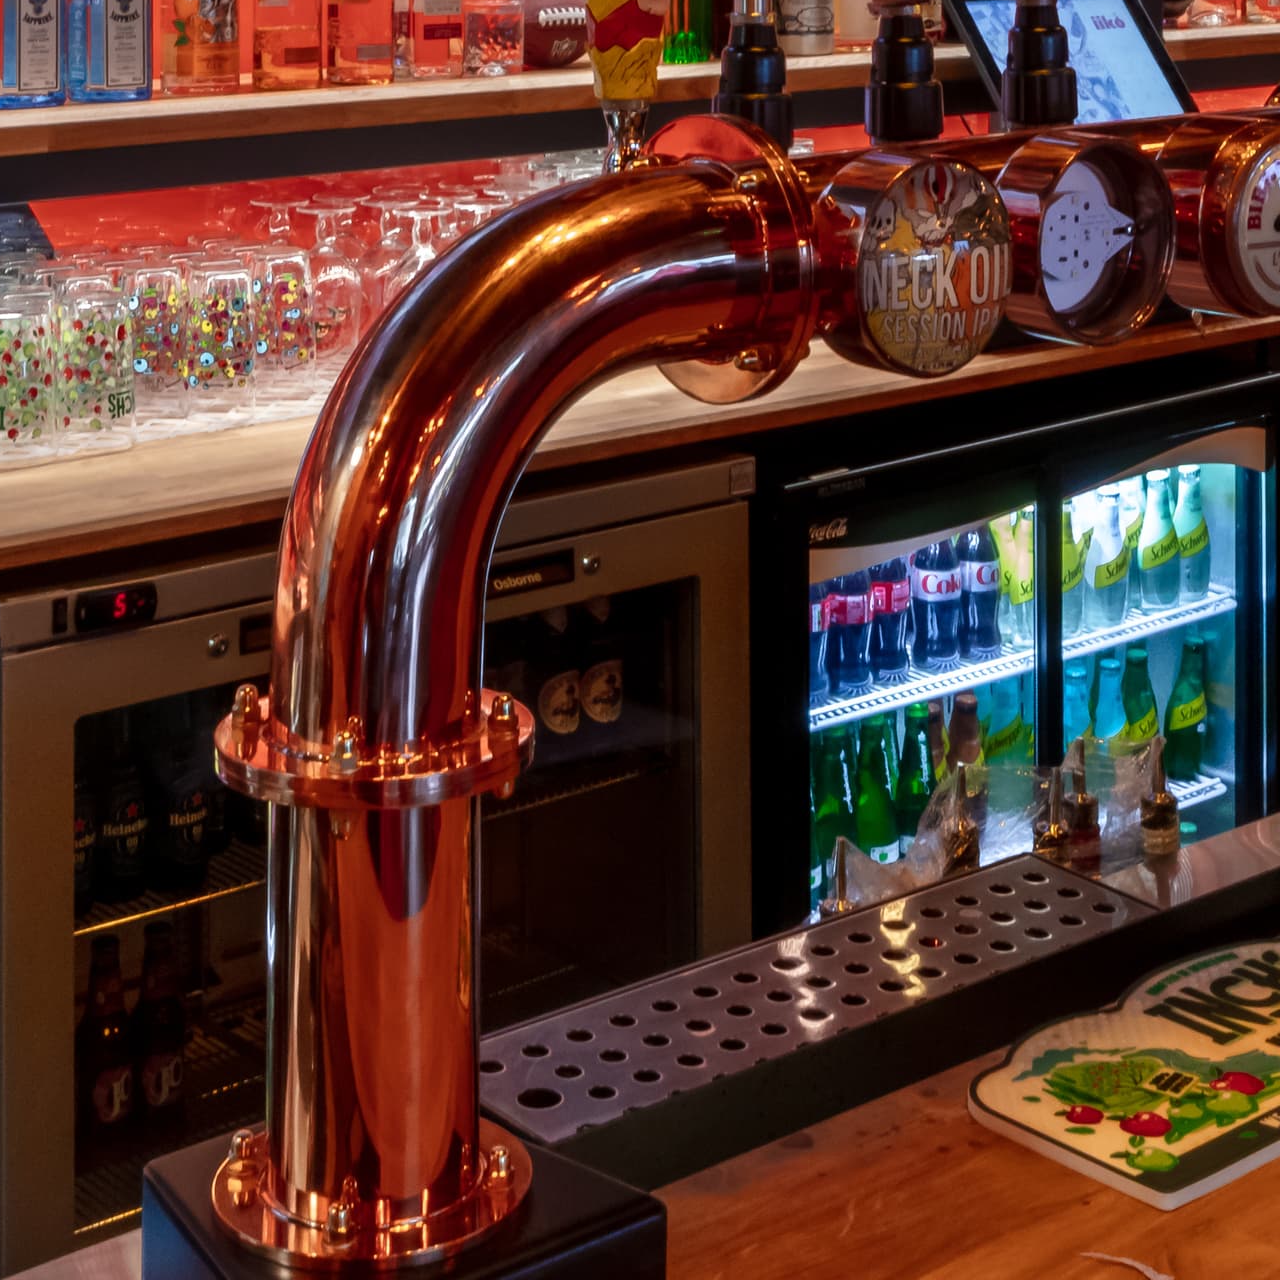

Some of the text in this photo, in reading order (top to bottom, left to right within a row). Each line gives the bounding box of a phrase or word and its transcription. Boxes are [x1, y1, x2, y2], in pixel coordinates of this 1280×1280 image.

[861, 242, 1012, 313] NECK OIL
[883, 310, 968, 343] SESSION
[493, 571, 543, 592] Osborne
[921, 573, 961, 595] Cok
[113, 592, 128, 619] 5
